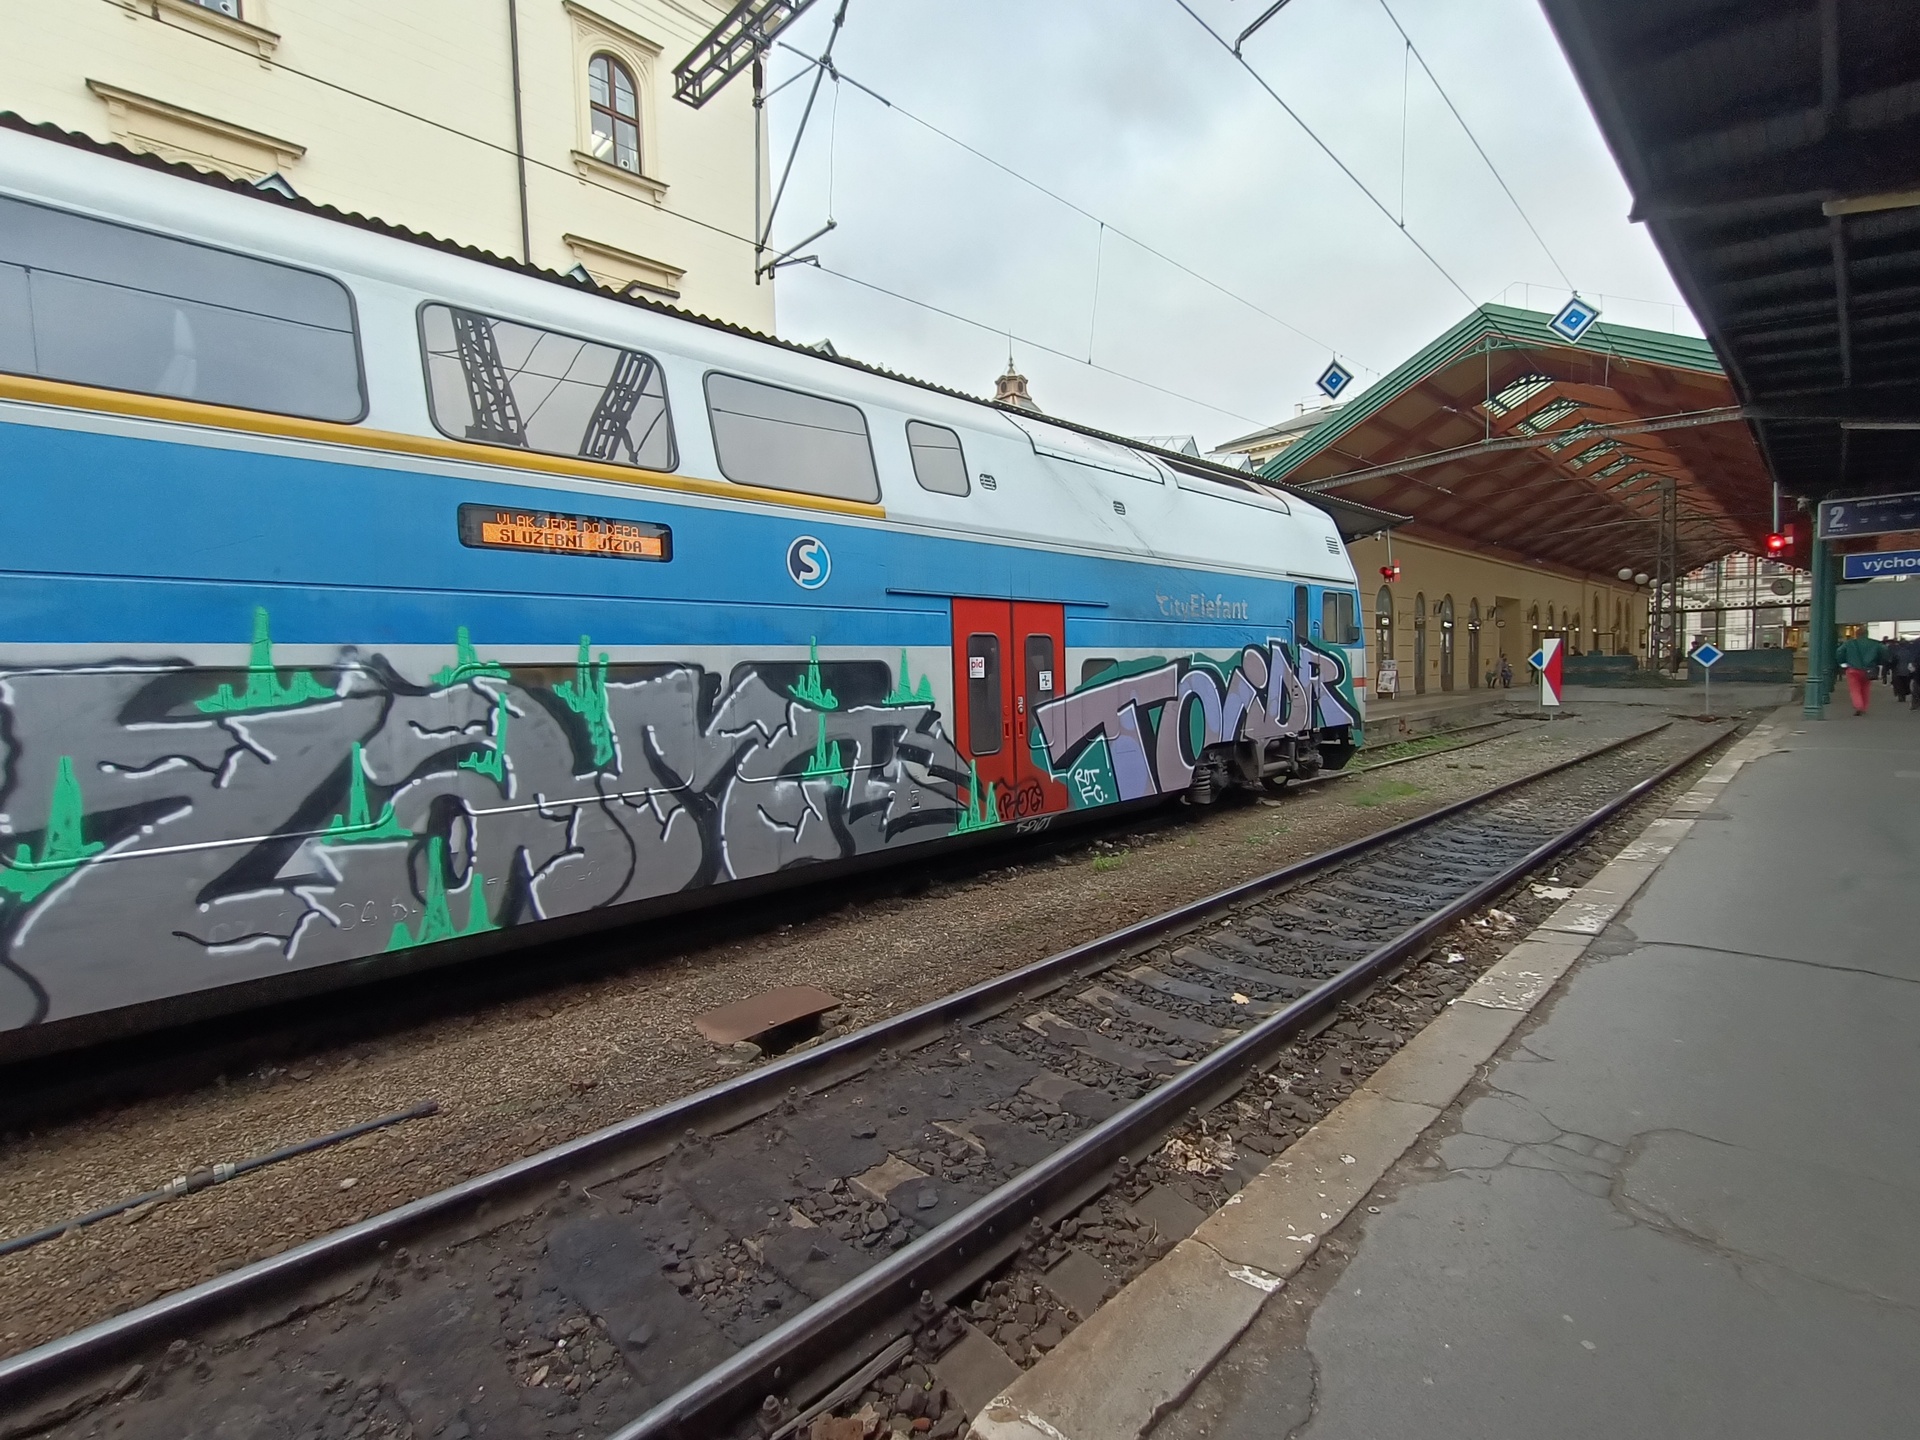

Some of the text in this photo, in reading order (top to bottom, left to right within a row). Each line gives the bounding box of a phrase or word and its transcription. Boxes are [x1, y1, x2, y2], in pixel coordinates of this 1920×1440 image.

[496, 512, 639, 537] VLAK JEDE DO DEPA
[500, 528, 642, 553] SLUŽEBNÍ JÍZDA
[1156, 592, 1248, 621] CityElefant
[971, 658, 983, 671] pid
